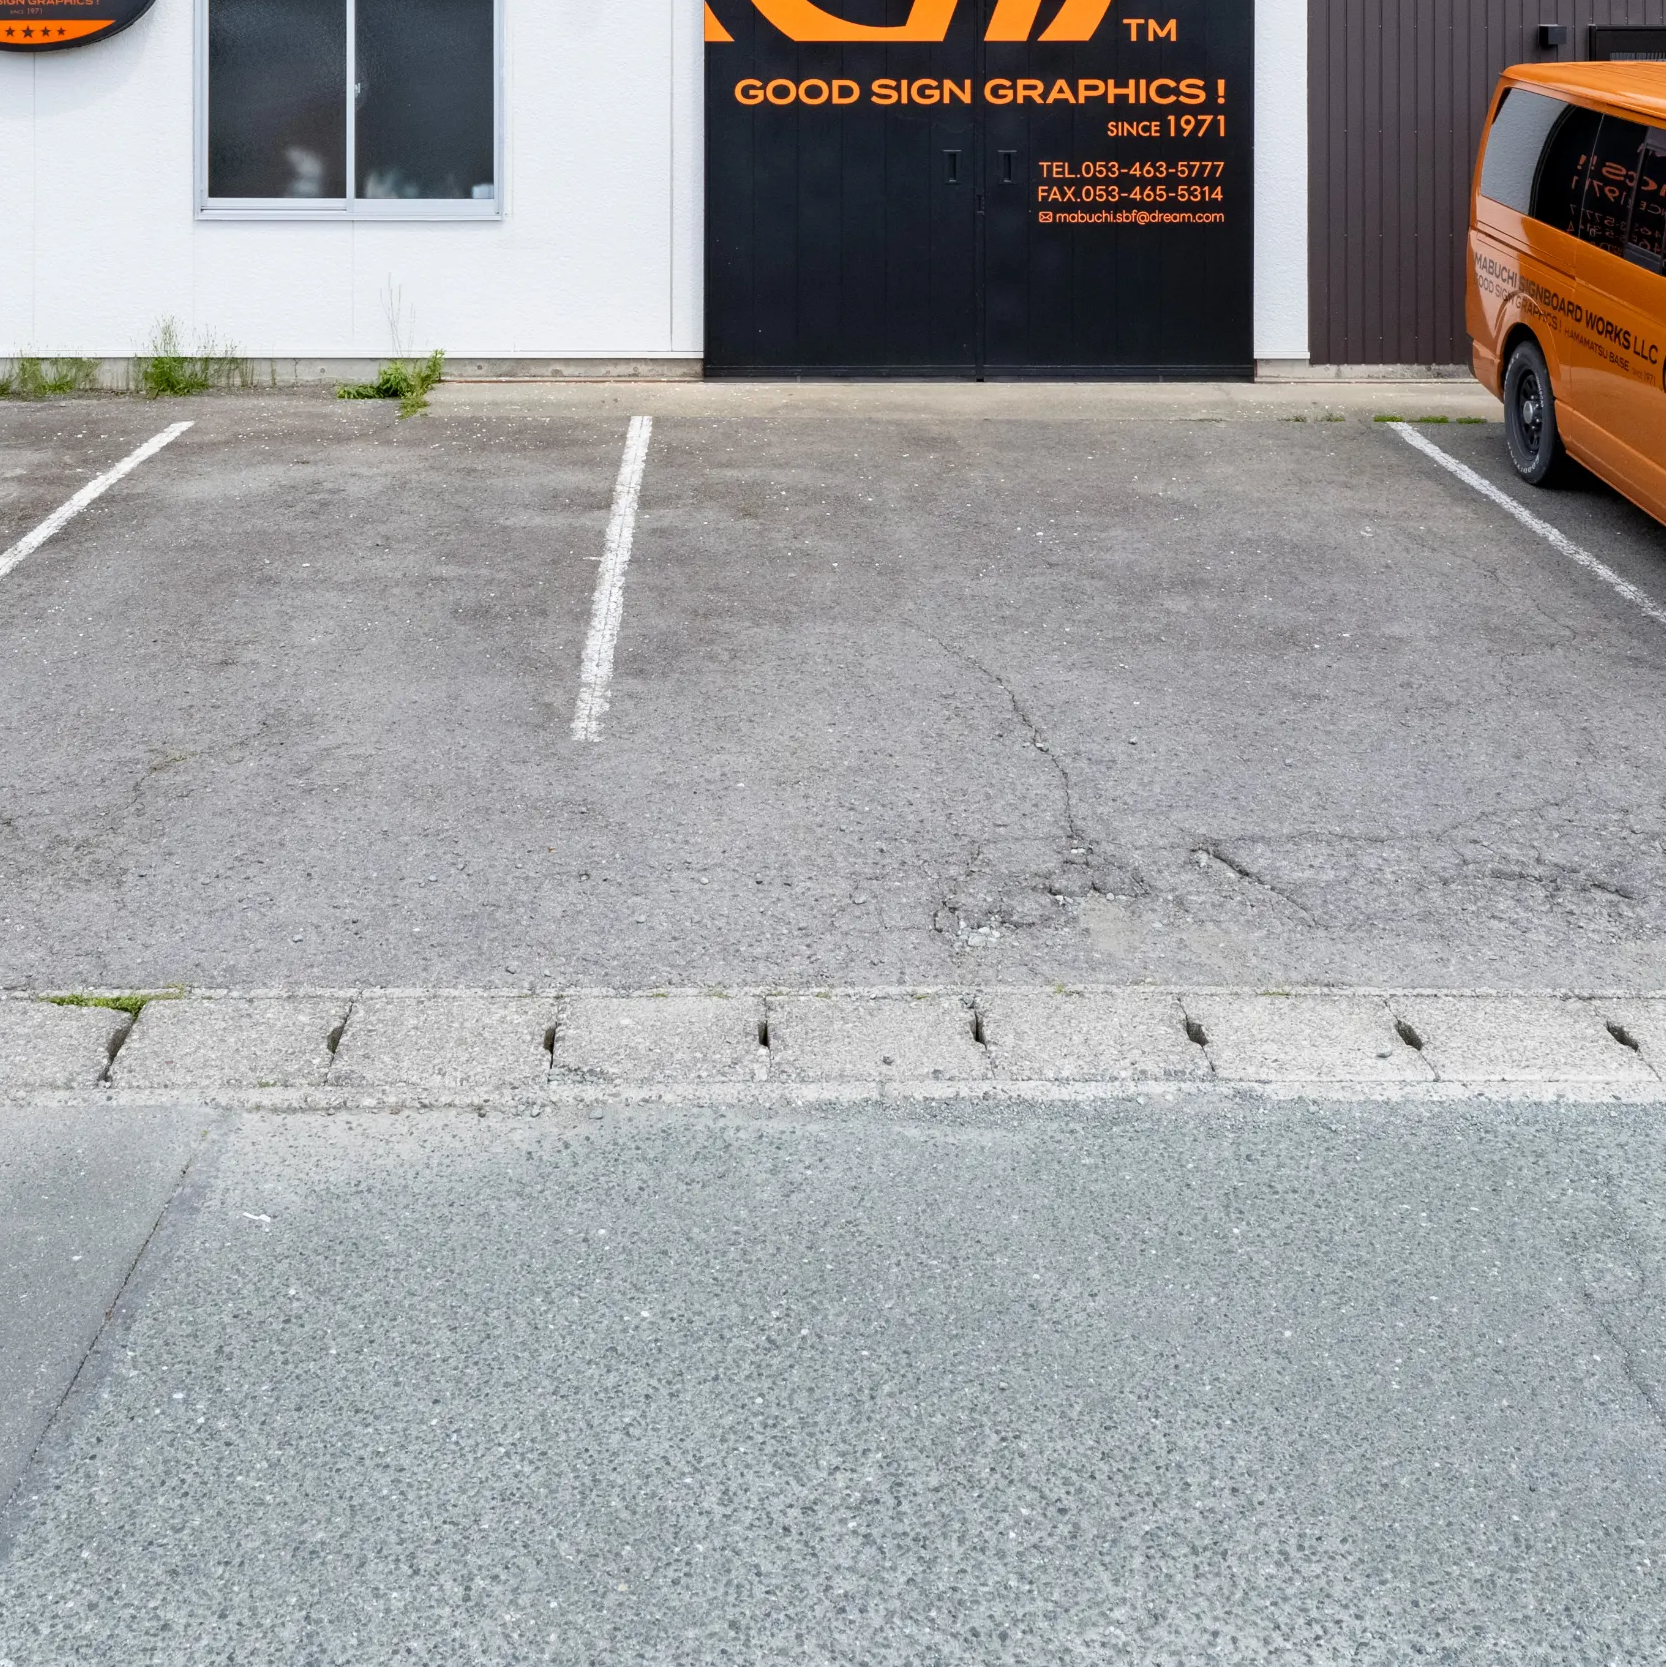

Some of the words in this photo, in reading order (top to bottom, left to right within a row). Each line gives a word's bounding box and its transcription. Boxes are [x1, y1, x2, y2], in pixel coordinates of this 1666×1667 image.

[27, 7, 43, 15] 1971
[1122, 18, 1177, 42] TM
[734, 78, 861, 105] GOOD
[870, 78, 971, 105] SIGN
[984, 78, 1207, 105] GRAPHICS
[1107, 121, 1161, 137] SINCE
[1167, 115, 1225, 137] 1971
[1038, 161, 1225, 179] TEL.053-463-5777
[1038, 185, 1224, 202] FAX.053-465-5314
[1056, 210, 1225, 225] mabuchi.sbf@dream.com
[1475, 252, 1517, 288] MABUCHI
[1518, 276, 1583, 323] SIGNBOARD
[1585, 309, 1631, 350] WORKS
[1633, 334, 1659, 365] LLC
[1516, 295, 1558, 331] GRAPHICS
[1564, 326, 1608, 360] HAMAMATSU
[1609, 351, 1630, 372] BASE
[1643, 370, 1656, 387] 1971
